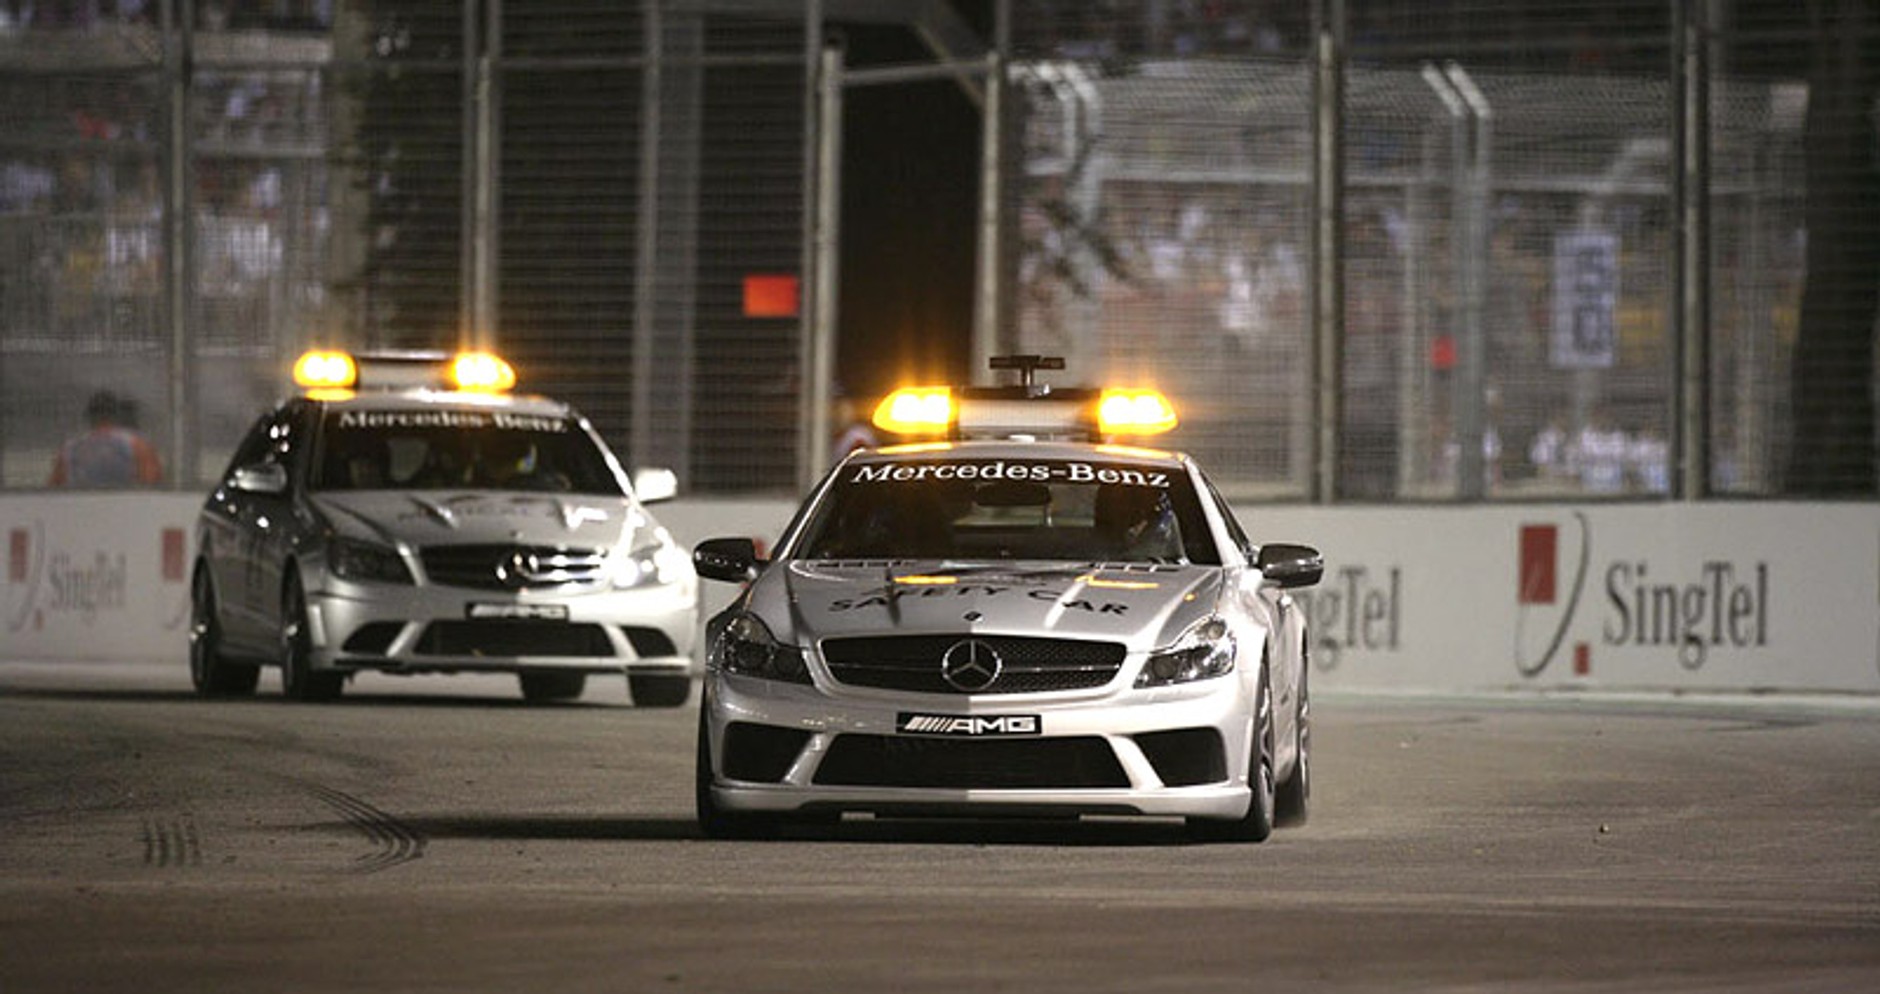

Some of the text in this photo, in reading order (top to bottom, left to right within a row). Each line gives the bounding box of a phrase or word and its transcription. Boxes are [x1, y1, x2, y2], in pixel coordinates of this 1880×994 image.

[339, 411, 567, 432] Mercedes-Benz
[851, 461, 1170, 487] Mercedes-Benz
[829, 586, 1129, 615] SAFETY CAR
[1294, 564, 1402, 671] ngTel
[1603, 560, 1767, 670] SingTel
[945, 717, 1036, 734] AMG
